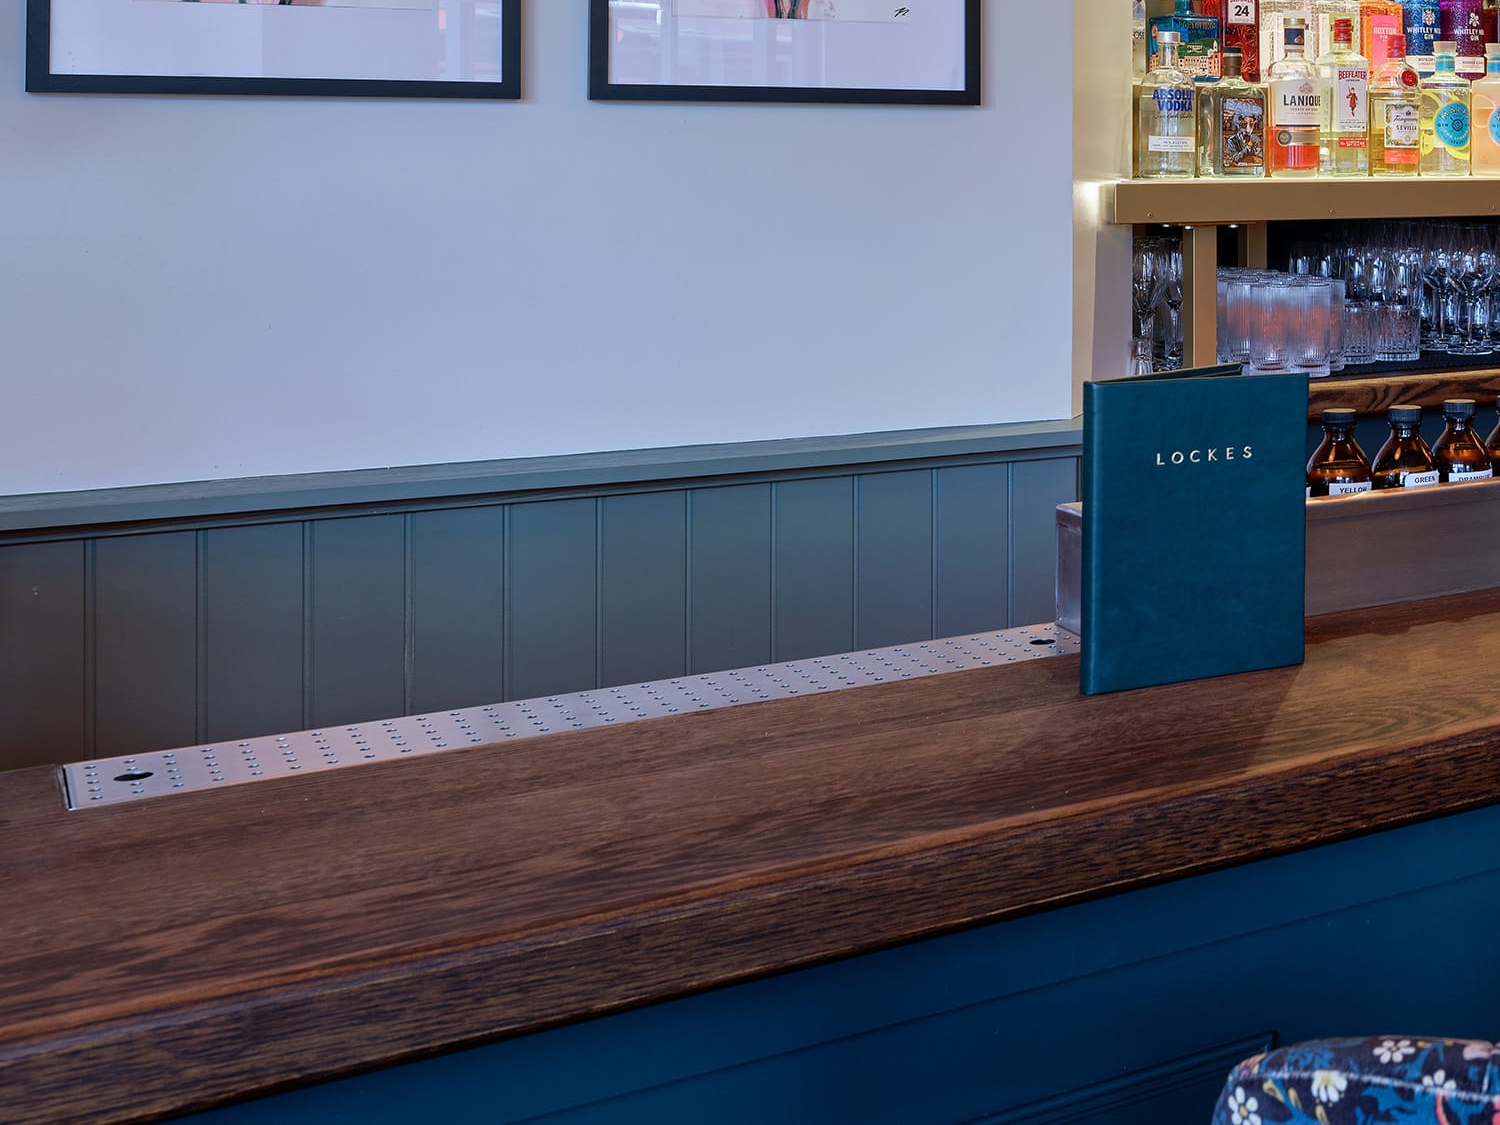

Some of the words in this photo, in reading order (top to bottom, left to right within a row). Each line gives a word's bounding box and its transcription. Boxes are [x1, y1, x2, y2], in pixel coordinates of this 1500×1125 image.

[1234, 5, 1250, 17] 24
[1407, 27, 1433, 35] WHITLEY
[1338, 70, 1367, 80] BEEFEATER
[1157, 99, 1193, 111] VODKA
[1156, 445, 1253, 466] LOCKES
